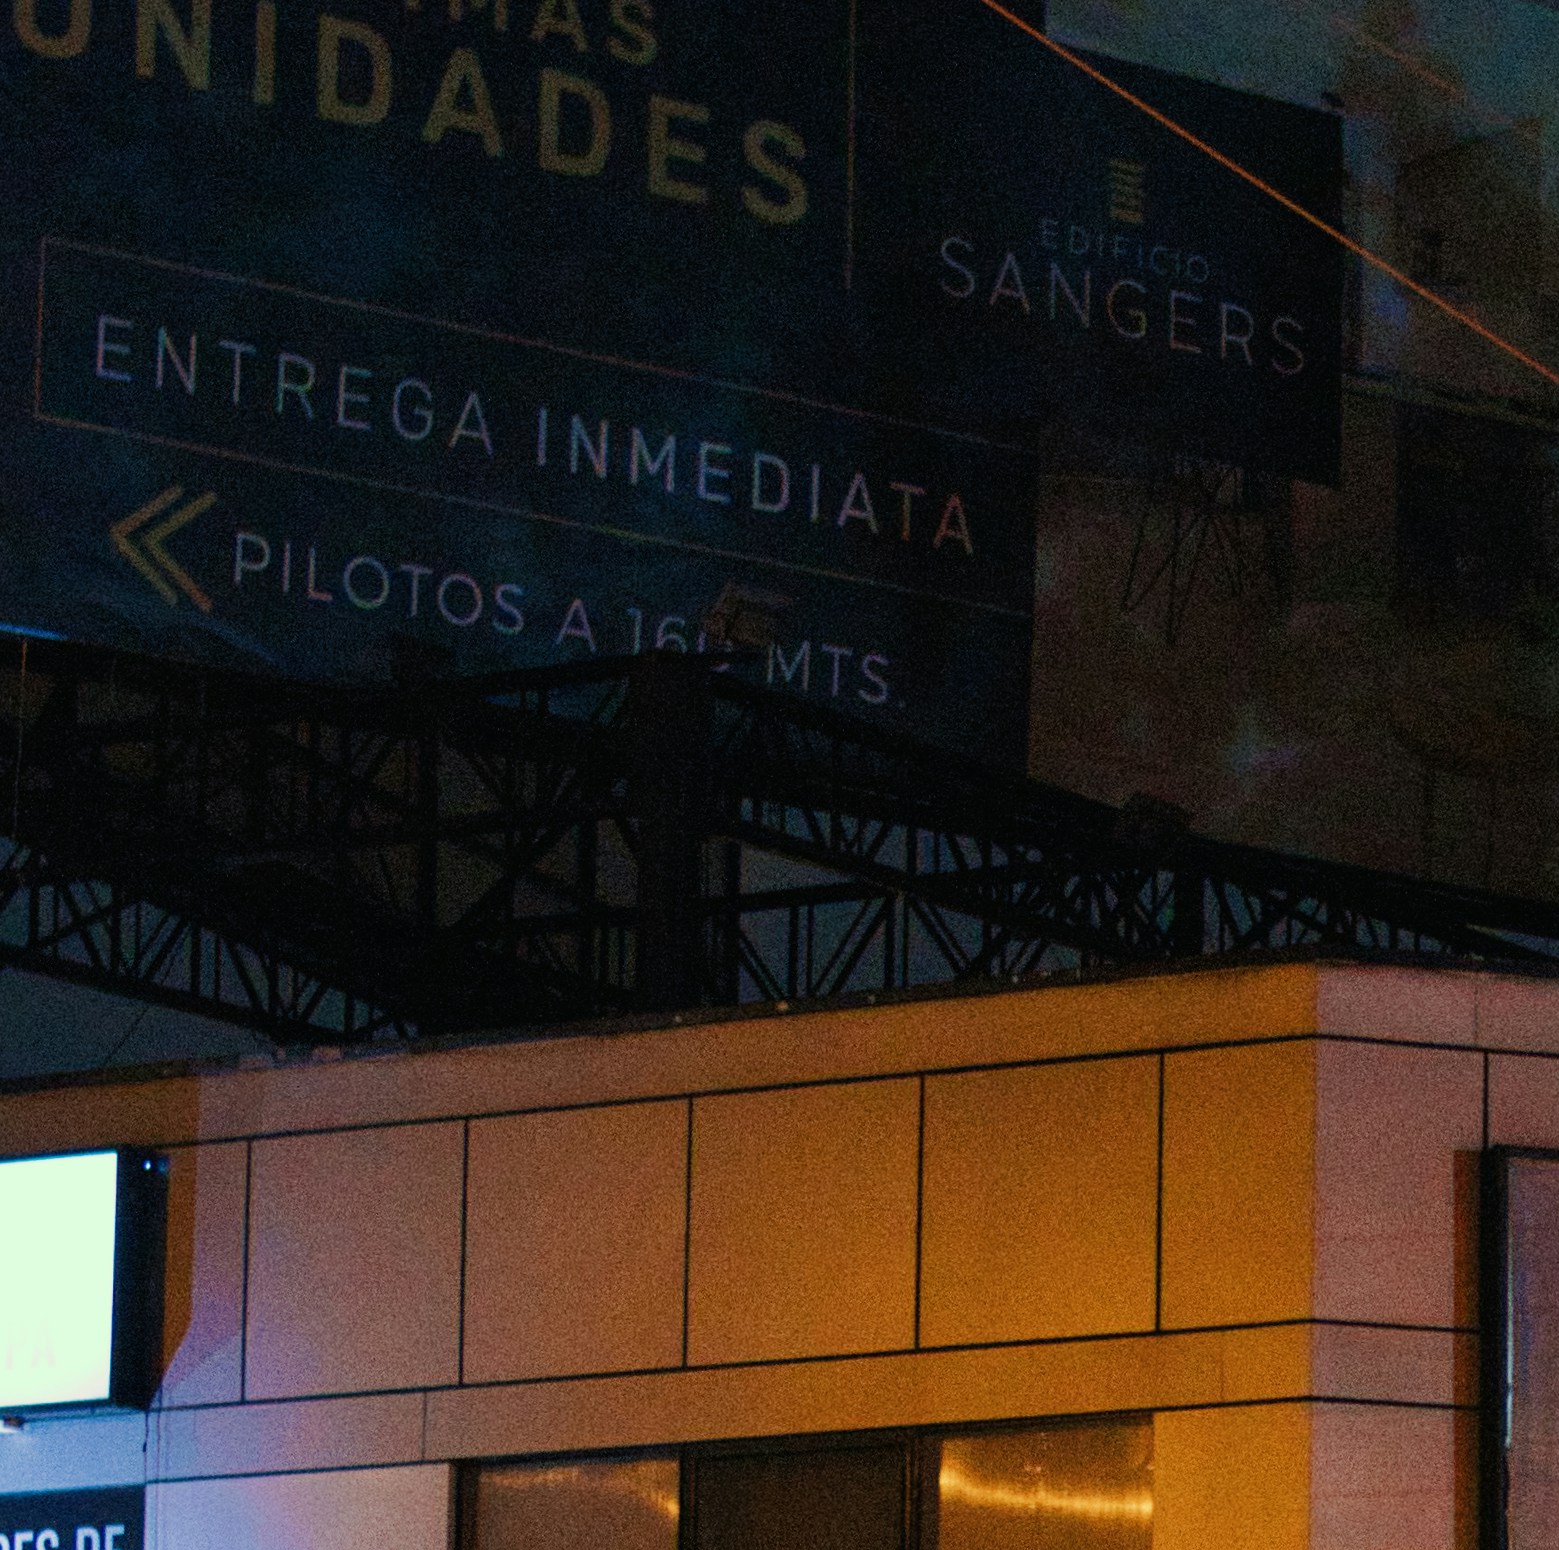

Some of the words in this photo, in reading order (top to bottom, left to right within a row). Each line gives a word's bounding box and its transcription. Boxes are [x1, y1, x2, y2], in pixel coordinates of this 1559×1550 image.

[13, 0, 810, 227] UNIDADES
[938, 236, 1304, 375] SANGERS
[1039, 216, 1210, 285] EDIFICIO
[95, 315, 495, 458] ENTREGA
[536, 408, 974, 556] INMEDIATA
[233, 531, 527, 636] PILOTOS
[554, 598, 598, 652] A
